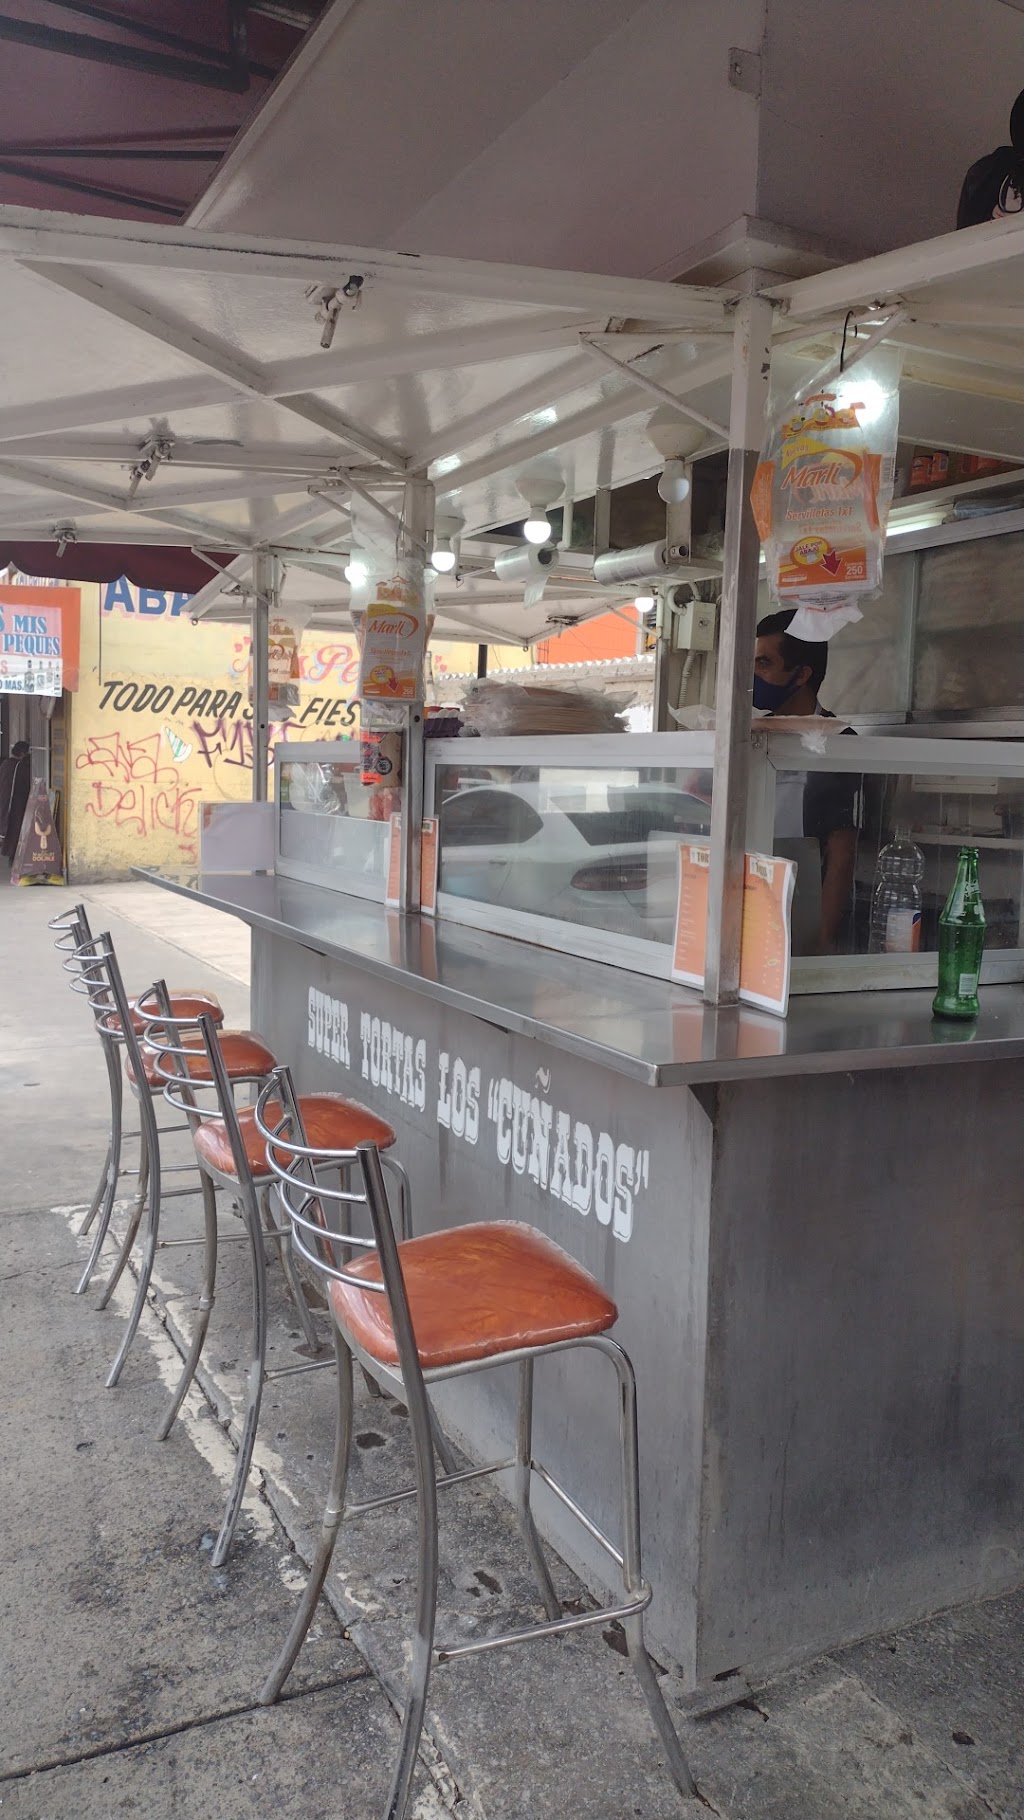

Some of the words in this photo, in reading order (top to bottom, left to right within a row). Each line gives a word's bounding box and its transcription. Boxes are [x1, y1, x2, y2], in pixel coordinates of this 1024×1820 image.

[781, 463, 842, 490] Marli
[786, 508, 835, 520] Servilletas
[846, 565, 863, 575] 250
[13, 614, 47, 634] MIS
[368, 620, 407, 636] Marli
[3, 634, 60, 656] PEQUES
[99, 681, 174, 714] TODO
[171, 687, 242, 719] PARA
[308, 986, 350, 1070] SUPER
[360, 1011, 426, 1112] TORTAS
[437, 1050, 481, 1145] LOS
